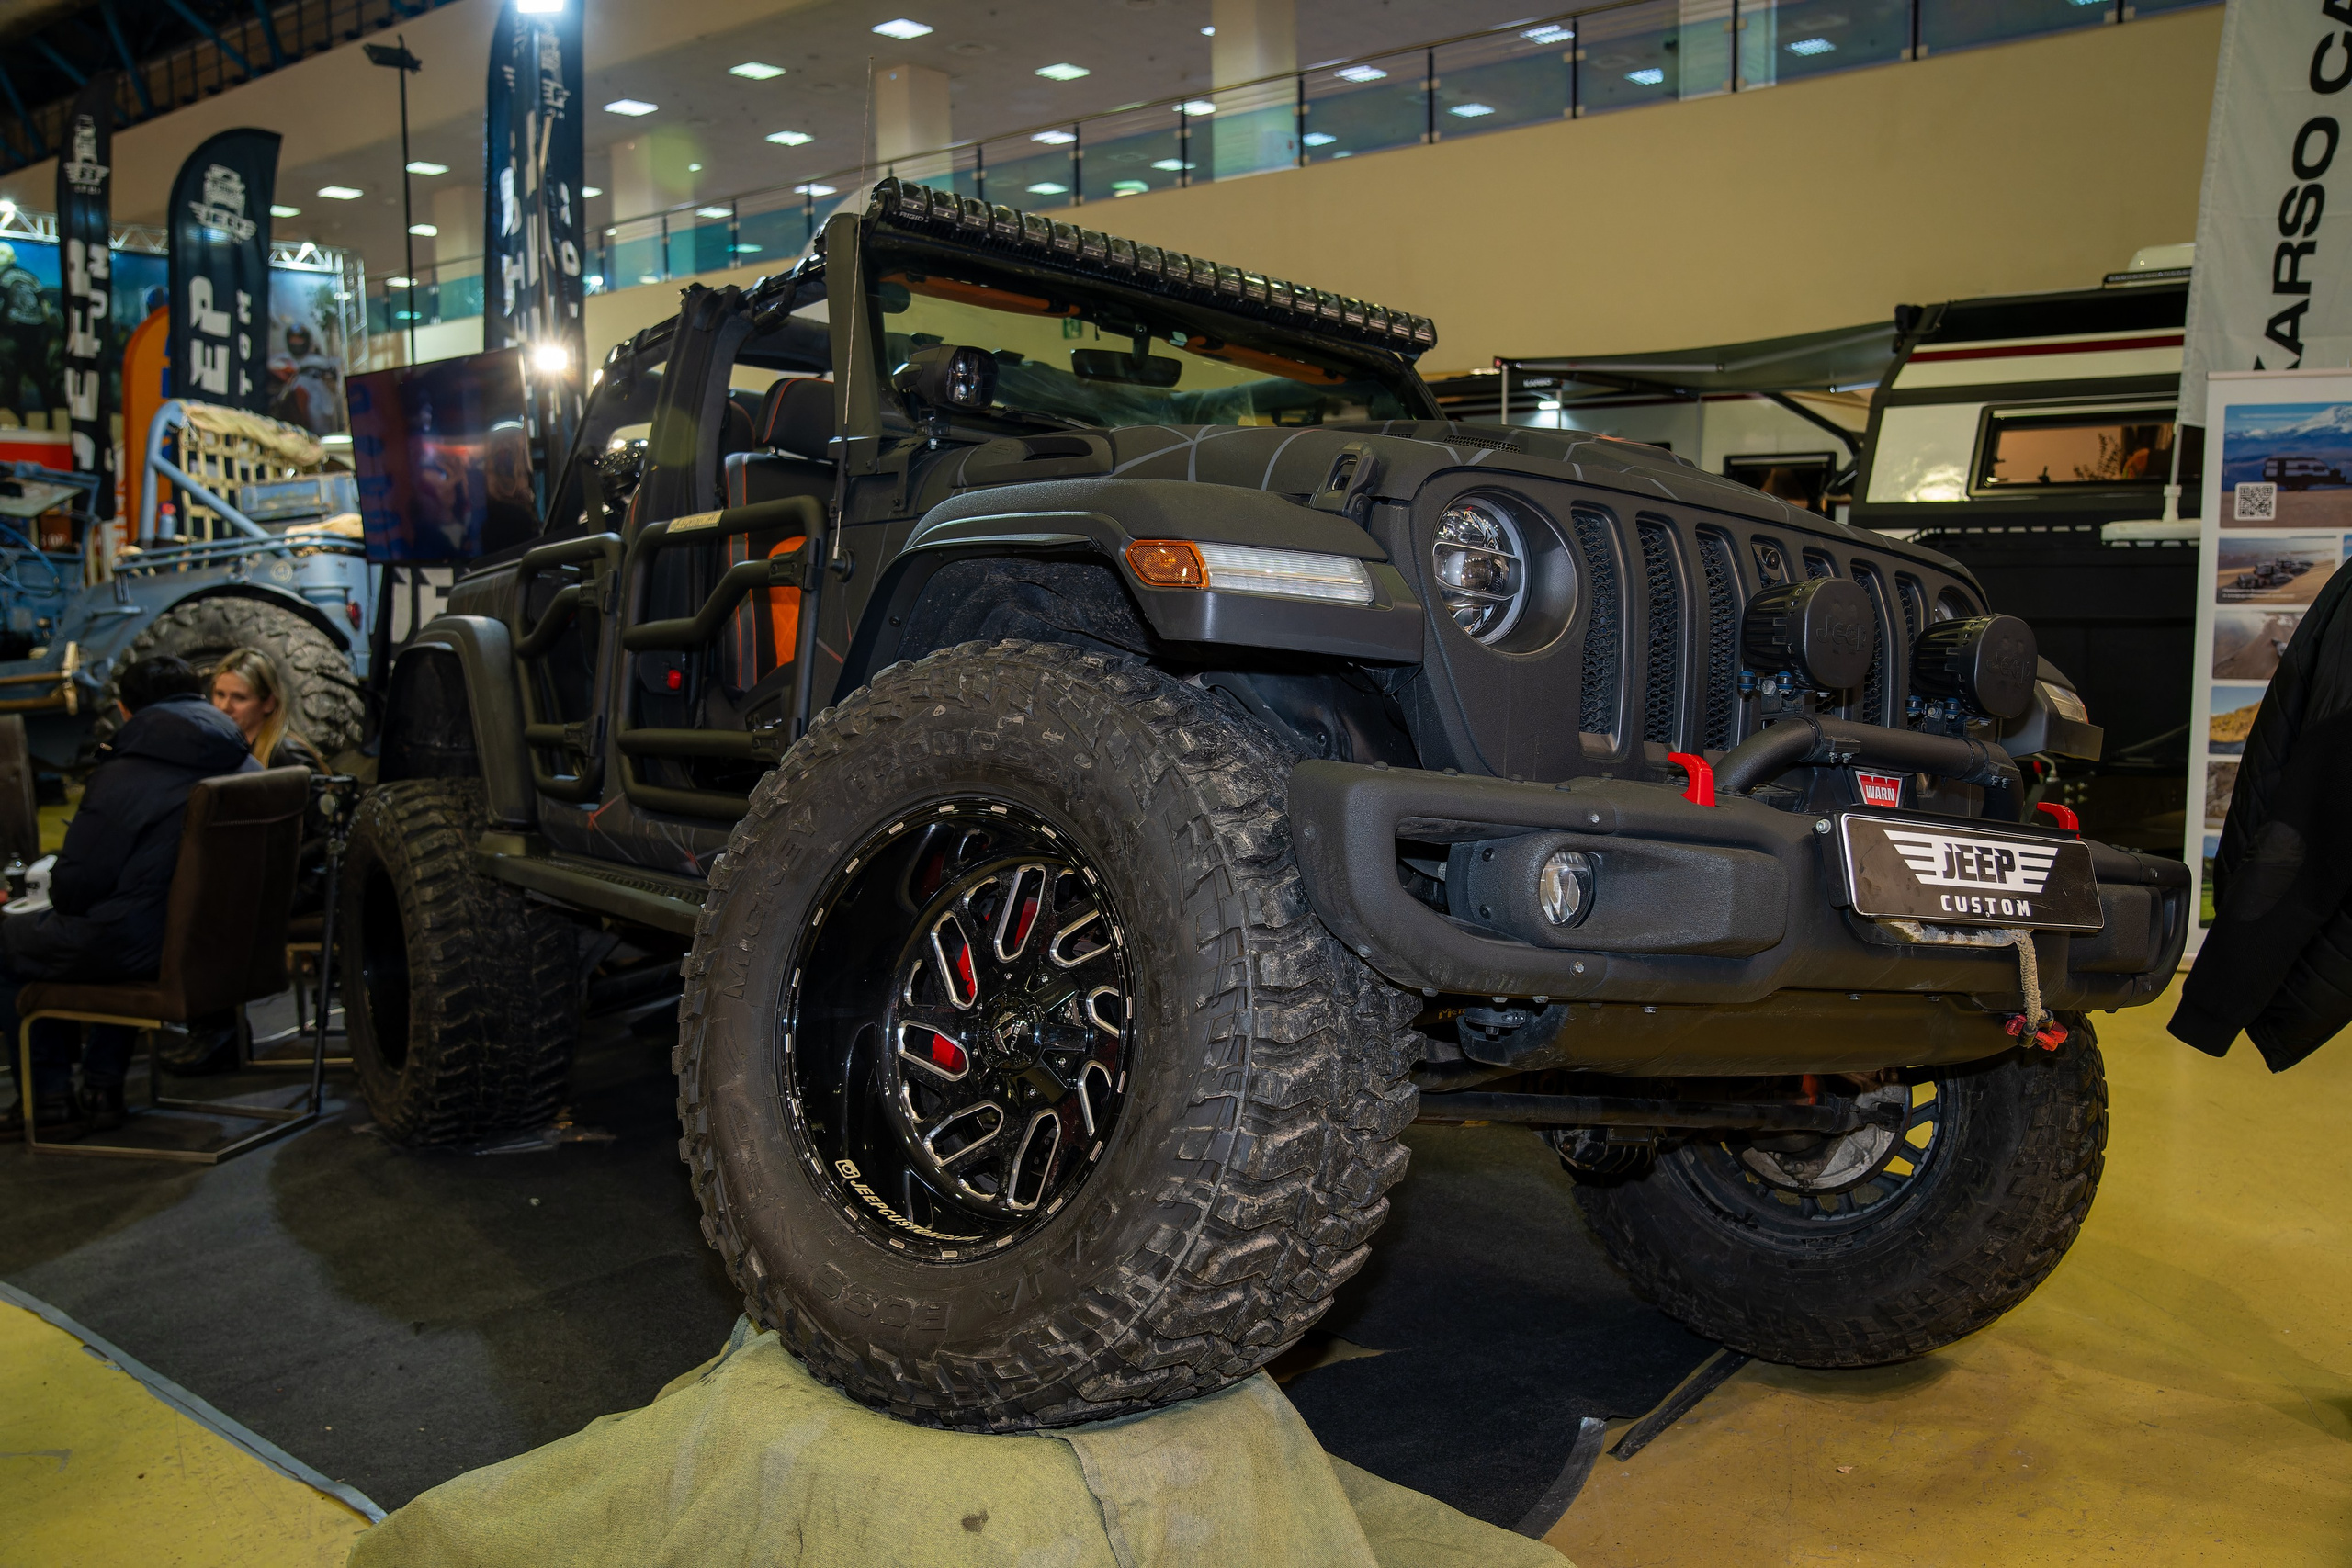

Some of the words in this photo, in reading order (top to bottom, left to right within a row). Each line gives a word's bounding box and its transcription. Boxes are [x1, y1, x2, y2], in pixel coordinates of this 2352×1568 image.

[899, 210, 925, 222] RIGID
[2253, 116, 2340, 371] ARSO
[187, 275, 232, 396] EP
[236, 289, 253, 397] TOM
[390, 566, 454, 643] JE
[1815, 615, 1868, 652] Jeep
[1985, 648, 2030, 684] Jeep
[1864, 784, 1895, 802] WARN
[1942, 842, 2016, 884] JEEP
[1940, 894, 2031, 917] CUSTOM
